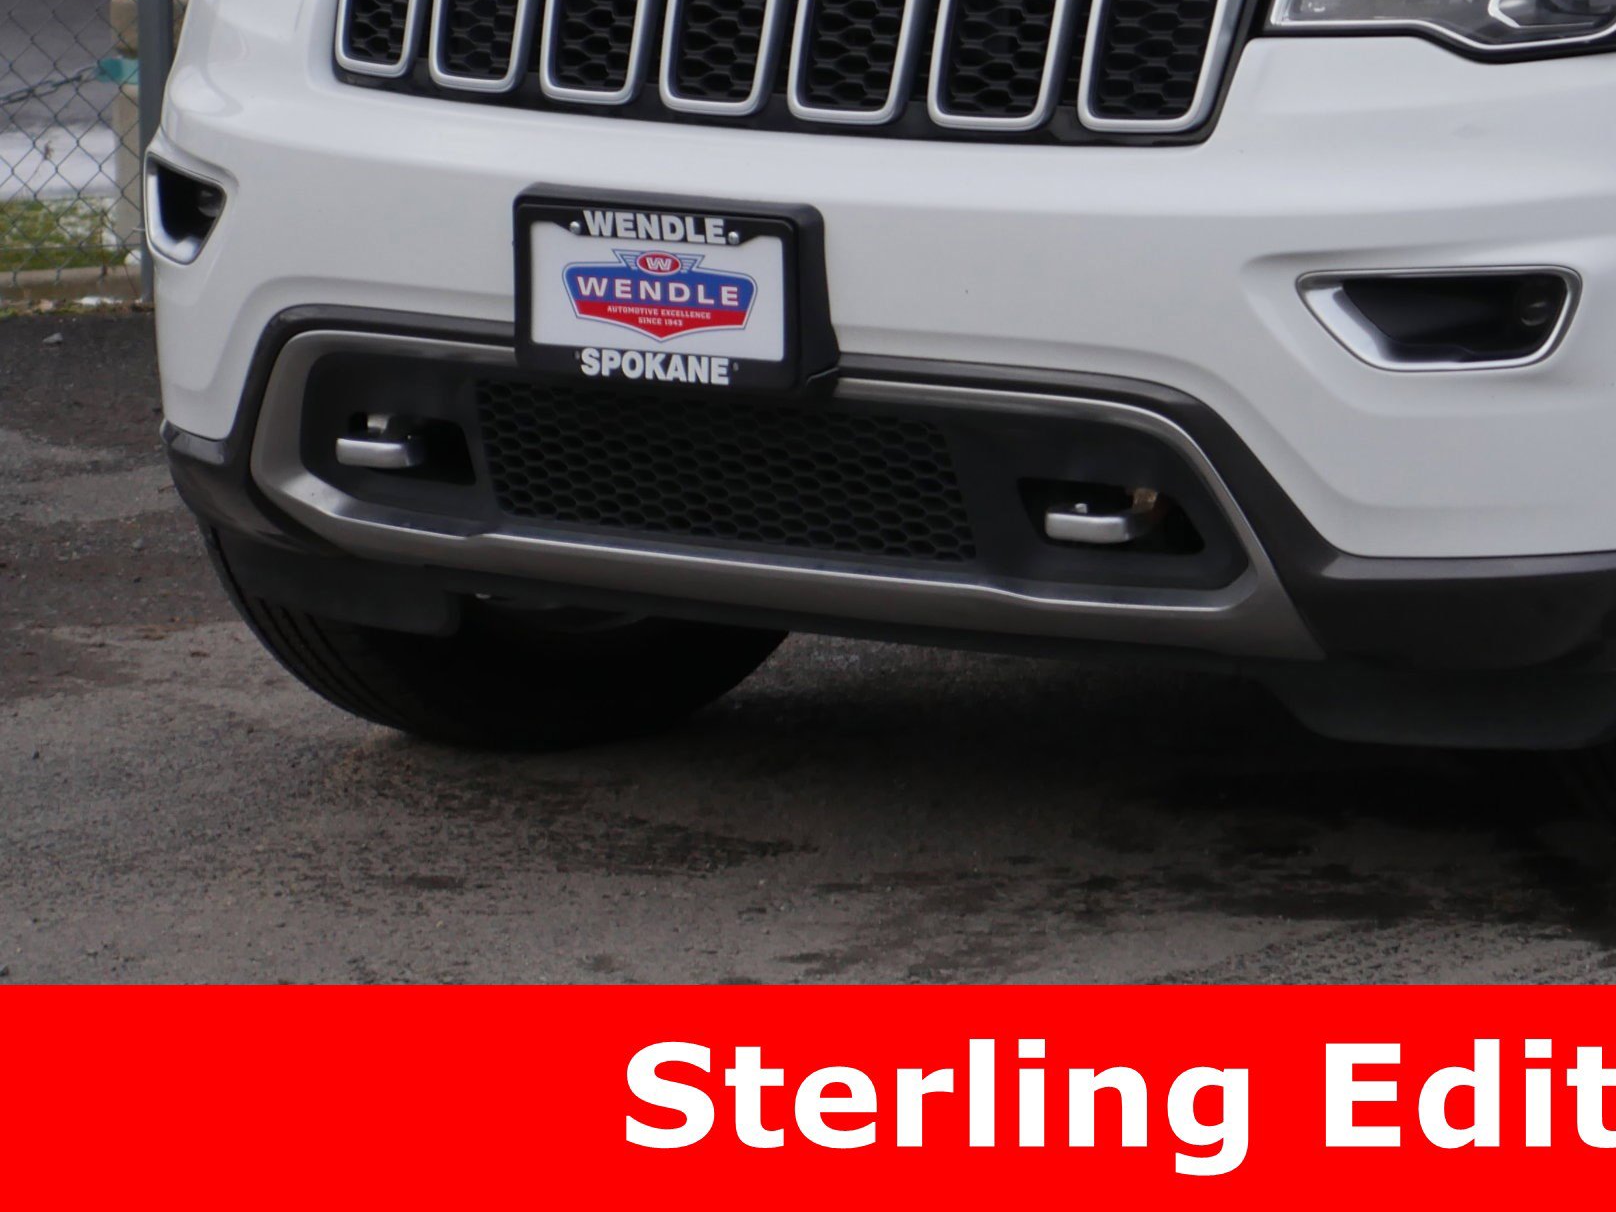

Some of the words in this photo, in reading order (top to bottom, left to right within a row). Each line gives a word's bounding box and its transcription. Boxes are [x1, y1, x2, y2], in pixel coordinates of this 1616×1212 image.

[583, 210, 726, 245] WENDLE
[577, 276, 739, 307] WENDLE
[607, 305, 658, 316] AUTOMOTIVE
[661, 309, 711, 319] EXCELLENCE
[638, 317, 662, 326] SINCE
[664, 319, 683, 327] 1943
[580, 348, 730, 385] SPOKANE
